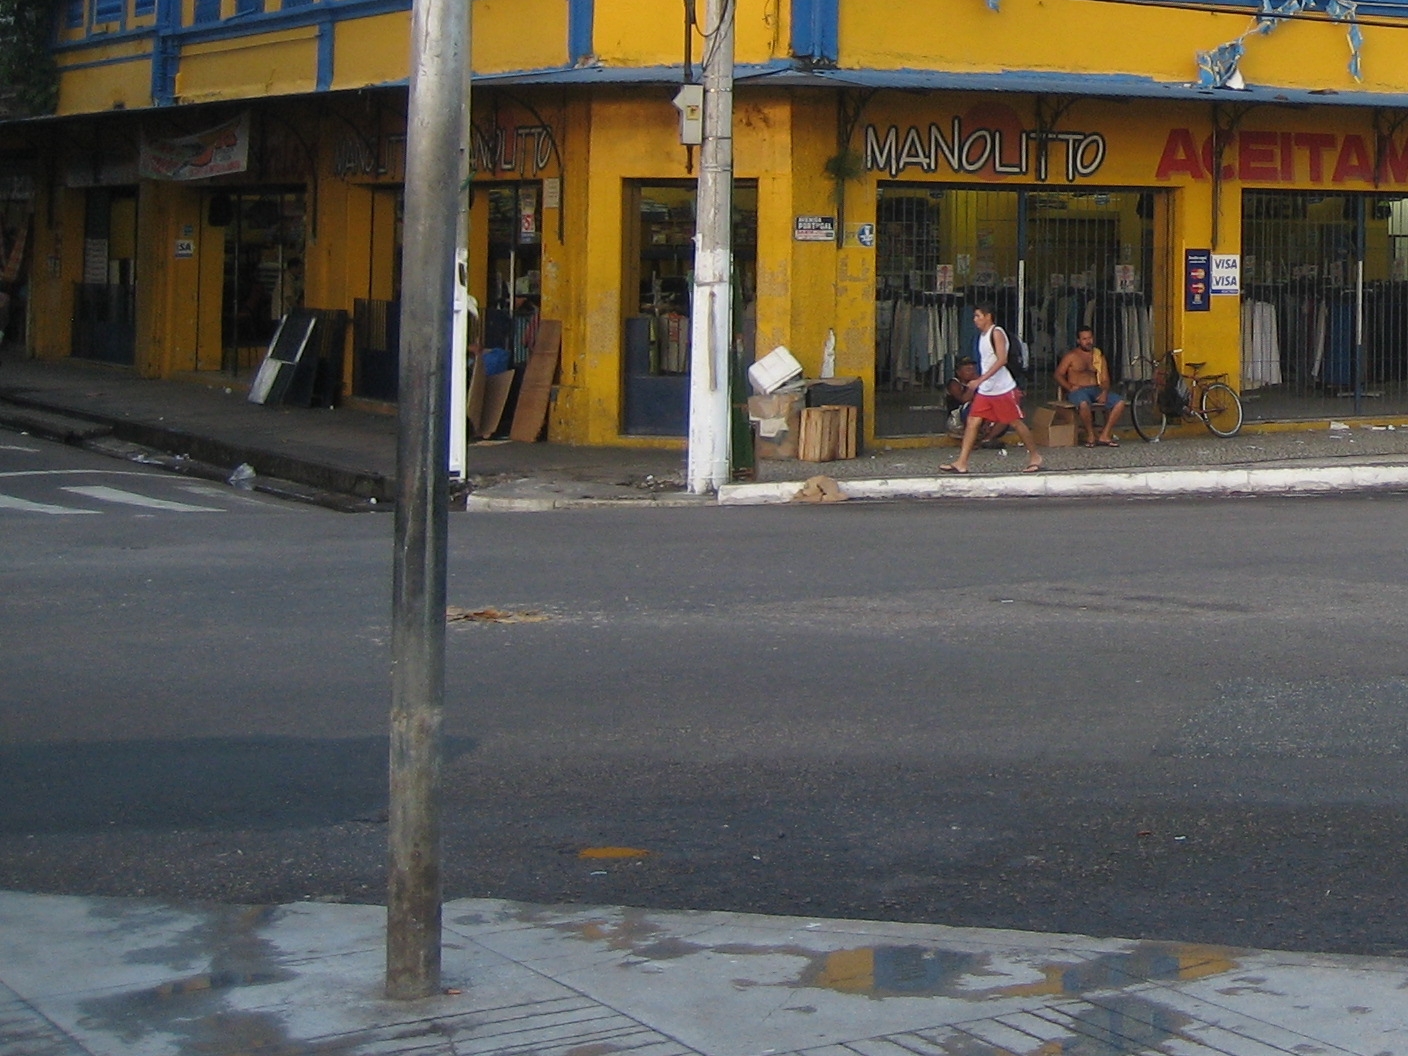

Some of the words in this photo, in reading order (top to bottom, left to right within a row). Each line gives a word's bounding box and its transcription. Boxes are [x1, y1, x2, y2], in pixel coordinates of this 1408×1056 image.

[863, 114, 1106, 183] MANOLITTO
[1214, 259, 1238, 269] VISA
[1213, 276, 1237, 287] VISA
